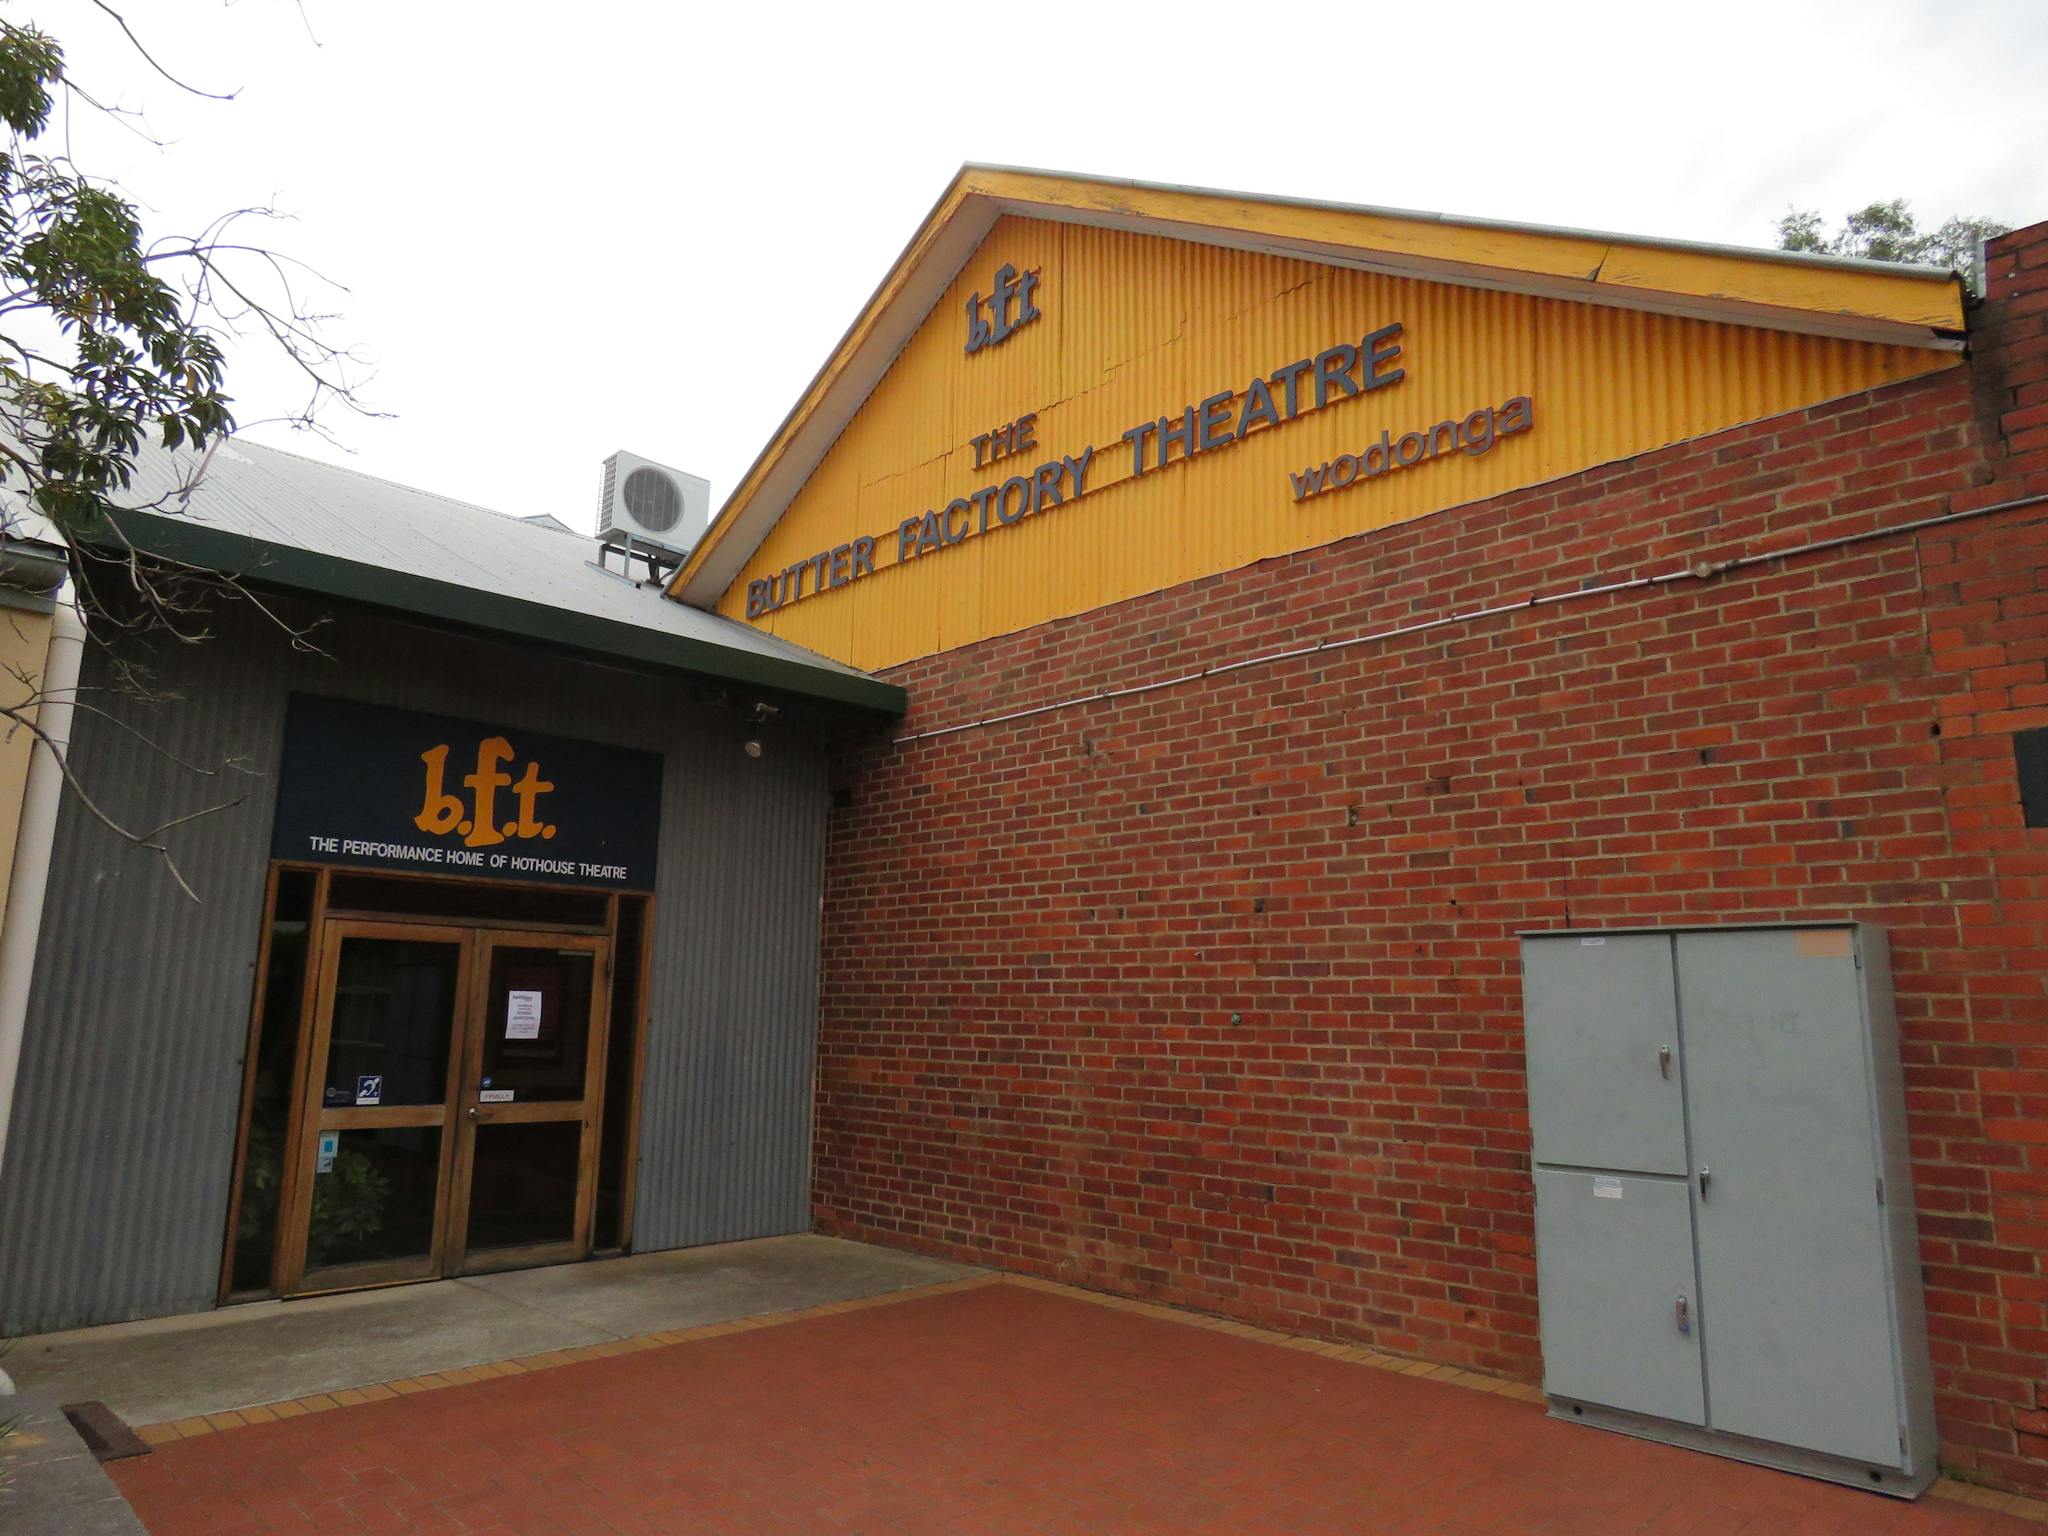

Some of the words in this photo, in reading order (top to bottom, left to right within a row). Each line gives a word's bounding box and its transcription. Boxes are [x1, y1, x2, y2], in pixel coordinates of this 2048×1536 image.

[745, 535, 875, 618] BUTTER
[897, 445, 1093, 562] FACTORY
[1123, 322, 1405, 477] THEATRE
[971, 413, 1038, 470] THE
[1289, 395, 1534, 501] wodonga
[309, 836, 339, 853] THE
[342, 839, 443, 863] PERFORMANCE
[446, 852, 484, 867] HOME
[490, 854, 508, 868] OF
[511, 856, 575, 875] HOTHOUSE
[579, 863, 627, 880] THEATRE
